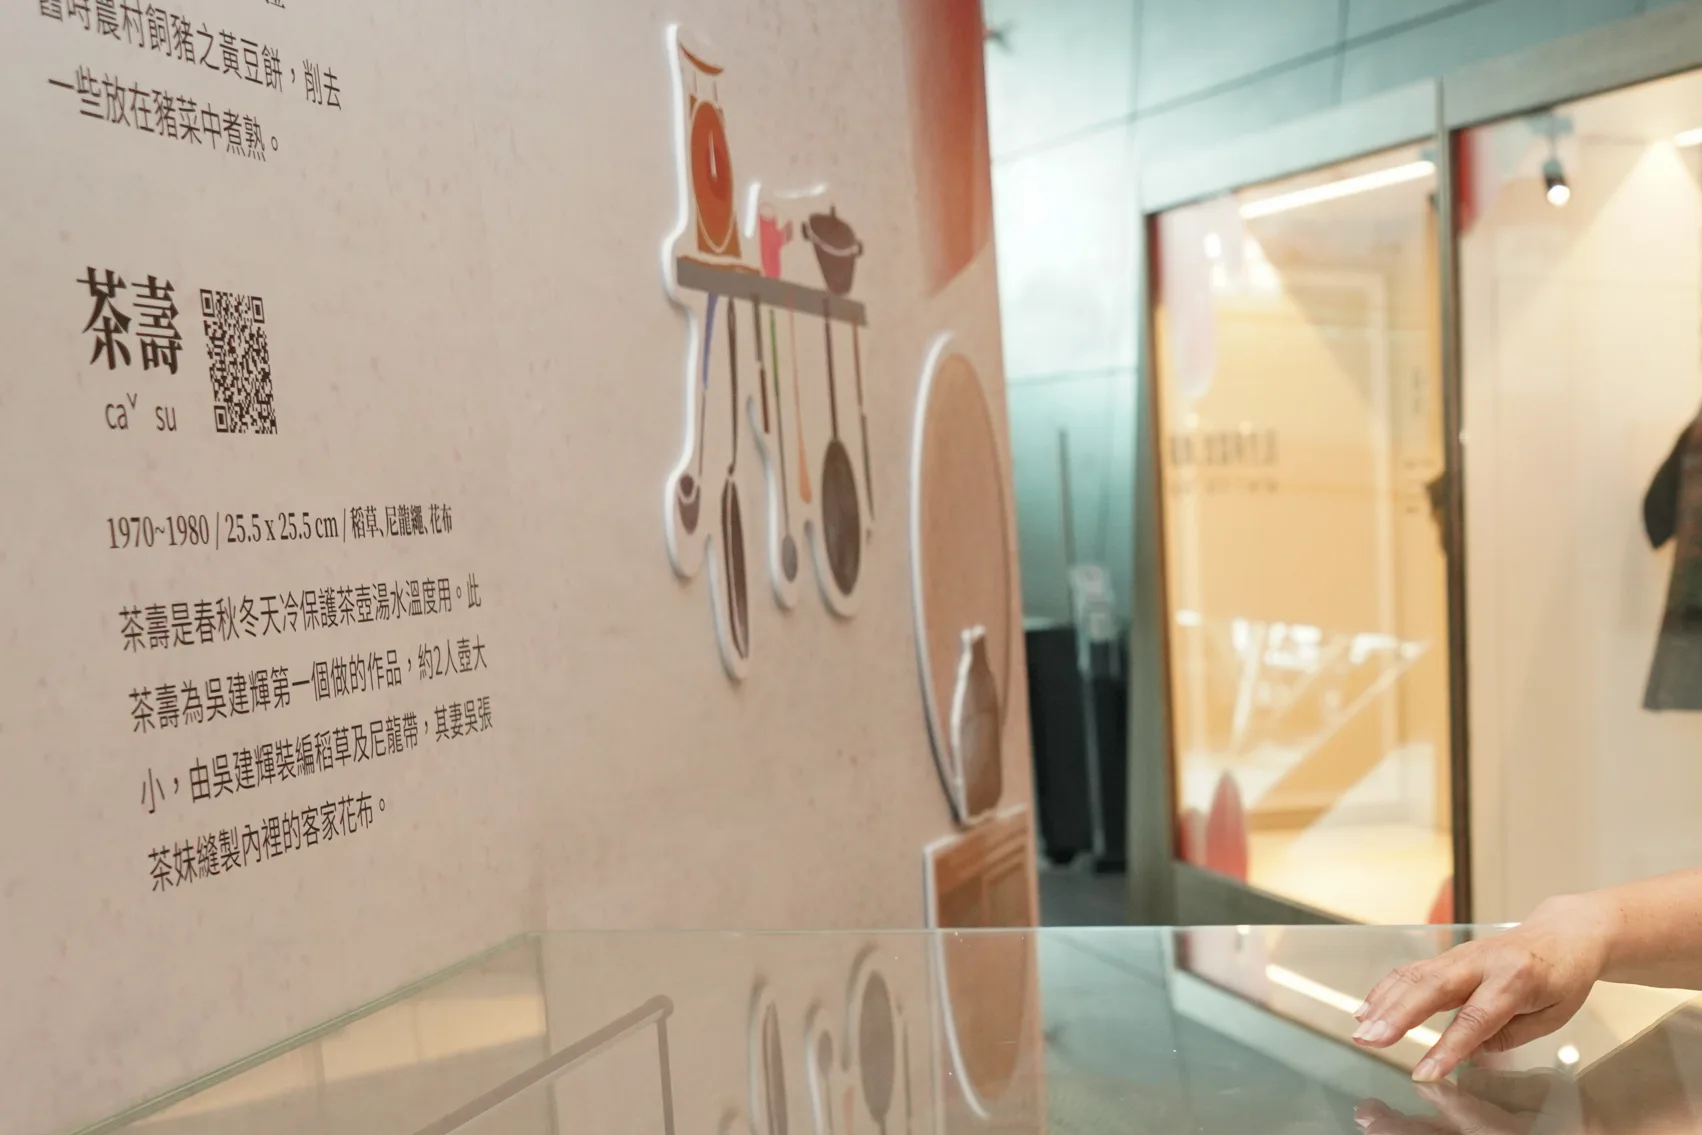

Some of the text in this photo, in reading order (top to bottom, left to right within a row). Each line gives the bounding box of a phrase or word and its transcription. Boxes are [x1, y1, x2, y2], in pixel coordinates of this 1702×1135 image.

[48, 65, 279, 161] 一些放在豬菜中煮熟。
[76, 266, 182, 375] 茶壽
[156, 403, 178, 431] su
[107, 514, 210, 549] 1970~1980
[225, 513, 261, 543] 25.5
[264, 519, 276, 541] x
[278, 512, 312, 540] 25.5
[315, 515, 340, 539] cm
